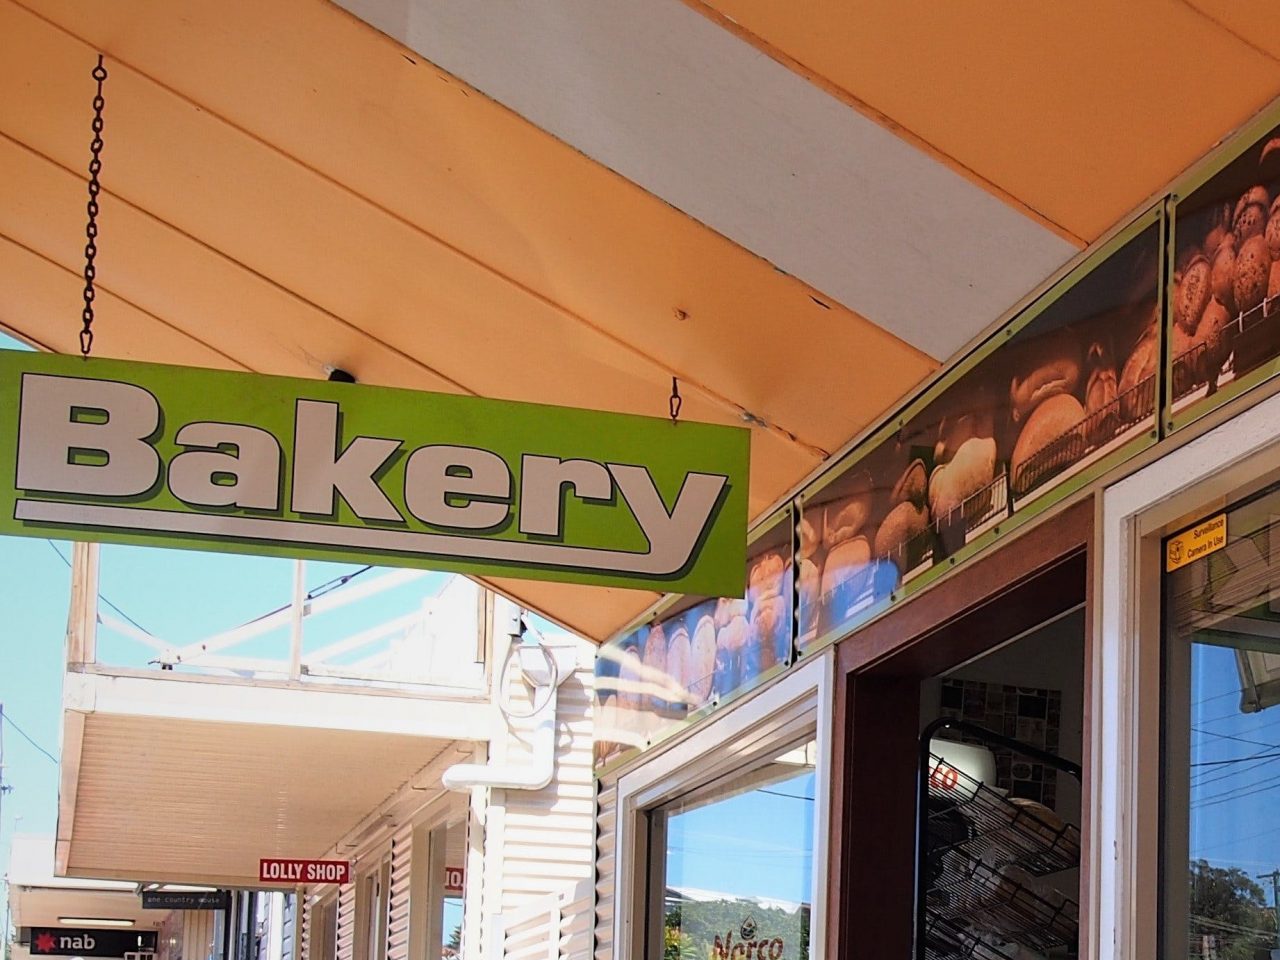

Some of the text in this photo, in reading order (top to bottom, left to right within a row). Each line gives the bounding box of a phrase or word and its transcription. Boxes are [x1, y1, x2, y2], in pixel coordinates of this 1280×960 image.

[14, 371, 730, 577] Bakery
[1193, 518, 1224, 540] Surveillance
[1187, 543, 1207, 558] Camera
[1213, 535, 1224, 547] Use
[262, 862, 346, 881] LOLLY SHOP
[59, 933, 96, 950] nab
